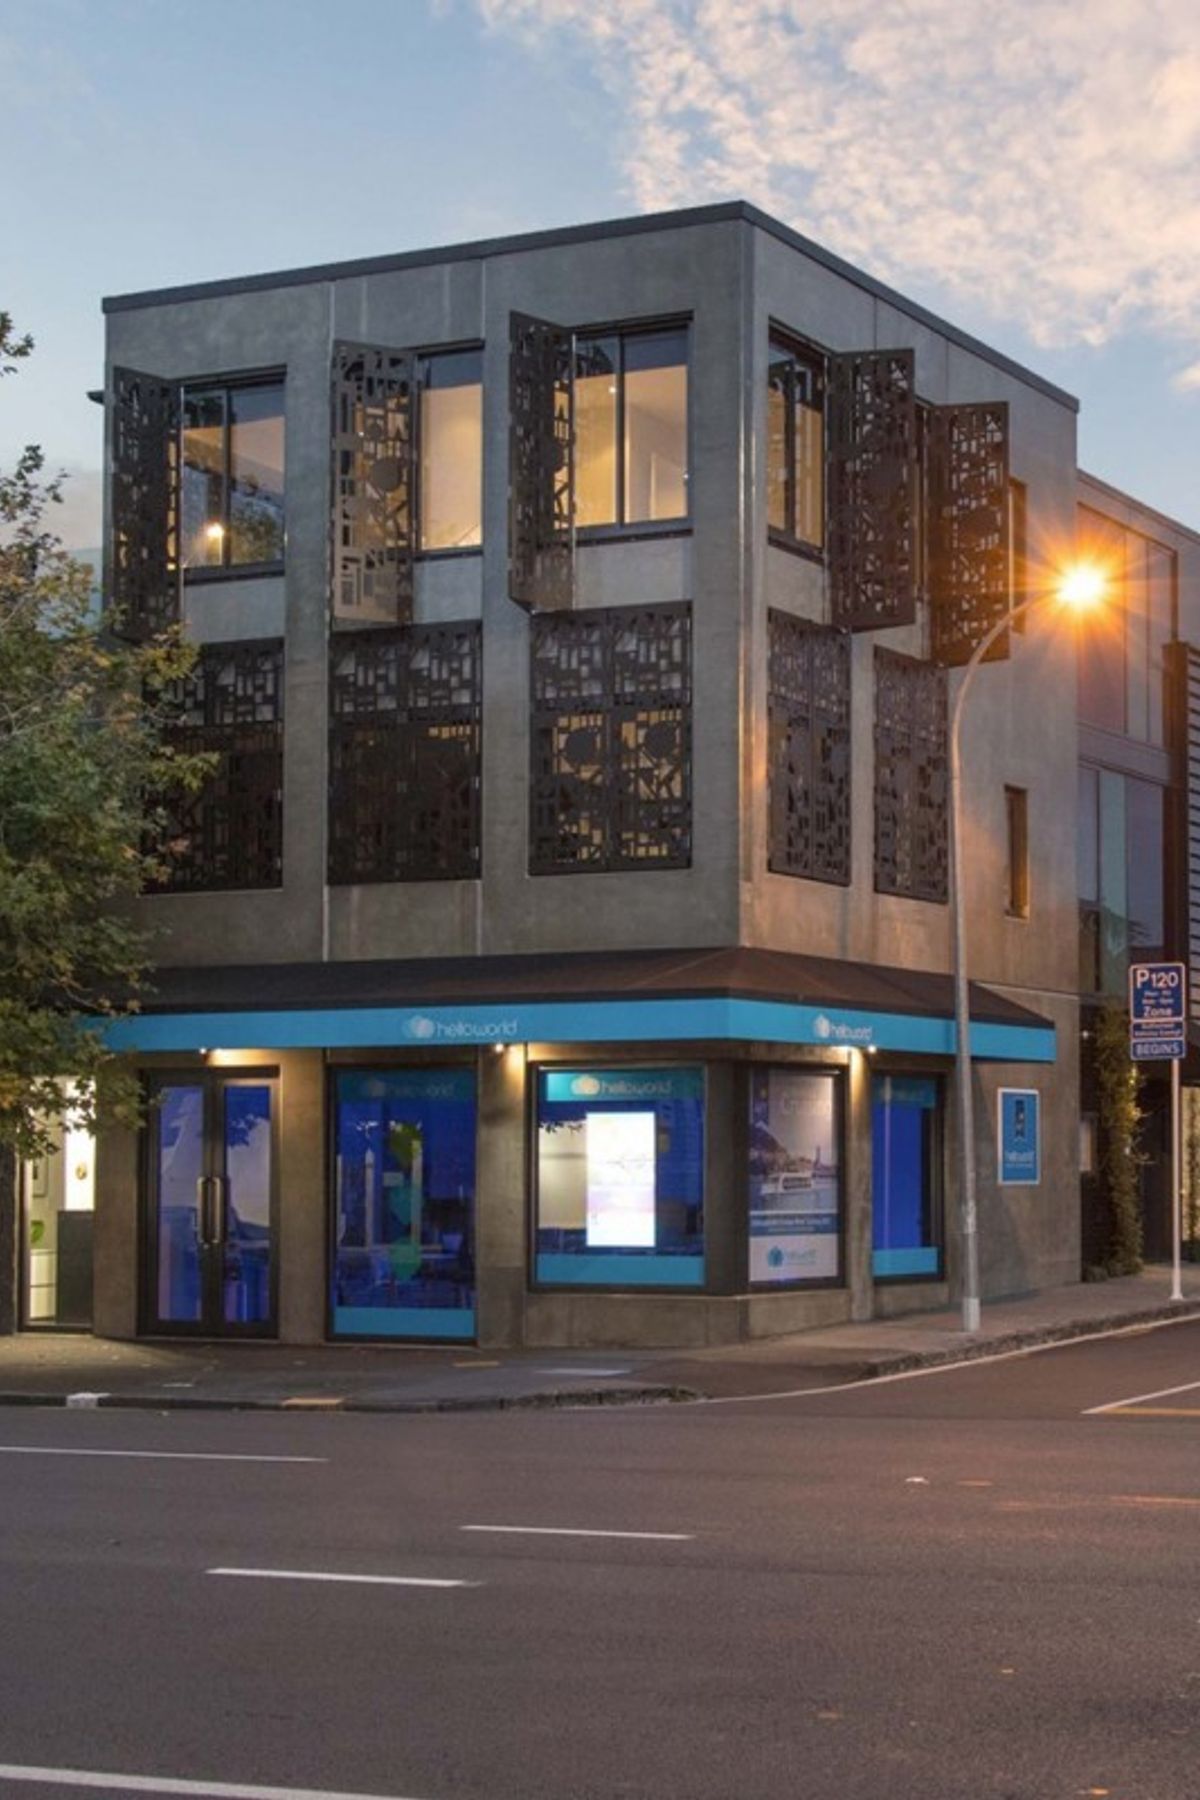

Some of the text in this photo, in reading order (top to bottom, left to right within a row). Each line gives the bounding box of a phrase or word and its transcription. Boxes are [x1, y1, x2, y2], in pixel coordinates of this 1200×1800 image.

[1143, 1005, 1173, 1017] Zone
[437, 1018, 518, 1038] helloworld
[1136, 1042, 1180, 1056] BEGINS
[601, 1080, 672, 1096] helloworld
